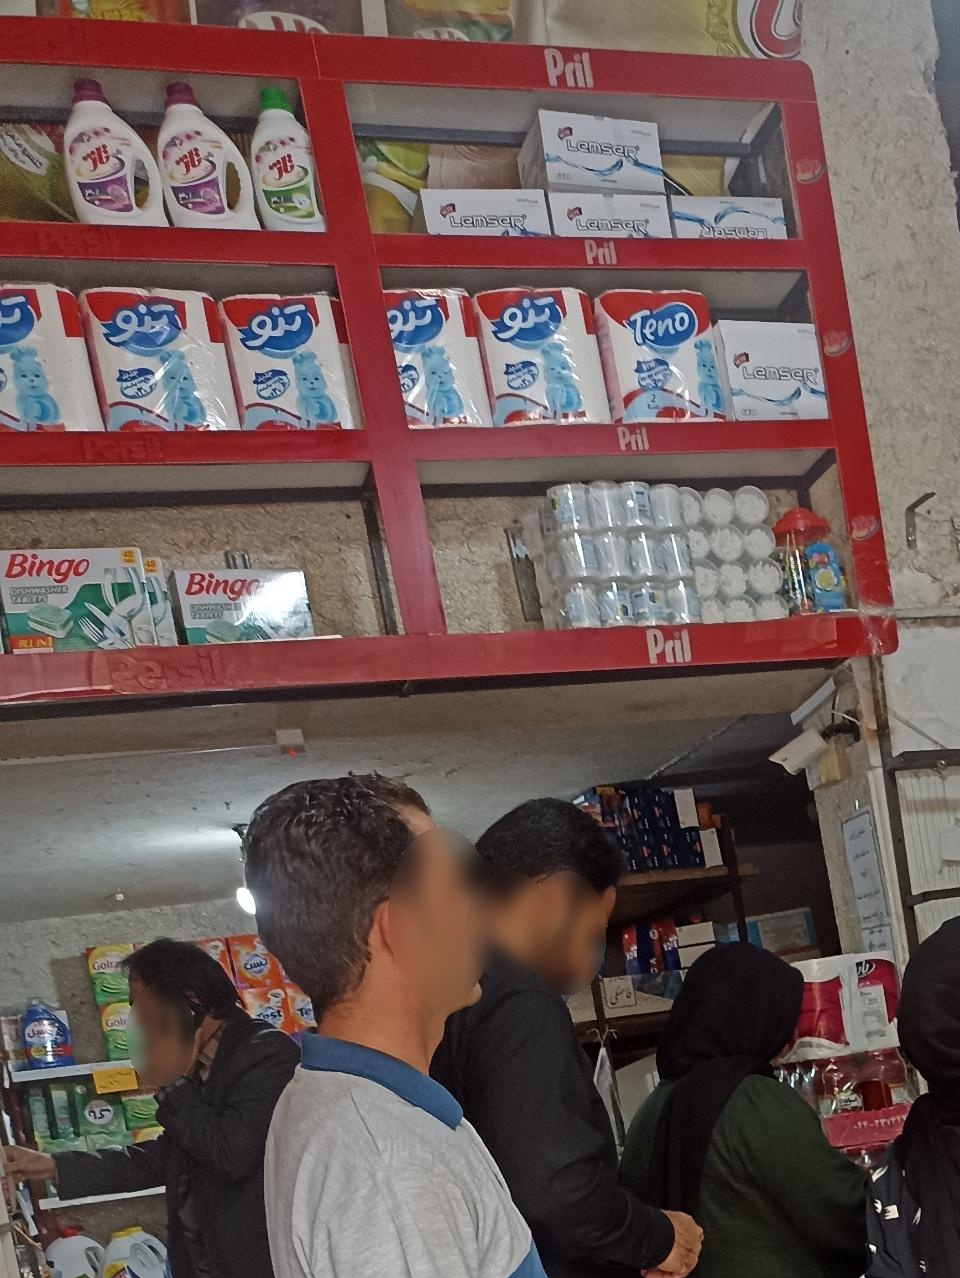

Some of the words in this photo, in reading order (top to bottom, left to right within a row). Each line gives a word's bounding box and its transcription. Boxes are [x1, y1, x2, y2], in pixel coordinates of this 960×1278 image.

[544, 48, 594, 89] Pril
[584, 240, 618, 265] Pril
[629, 310, 692, 344] Teno
[617, 426, 650, 452] Pril
[5, 553, 90, 584] Bingo
[645, 628, 692, 664] Pril
[297, 1007, 312, 1018] Te
